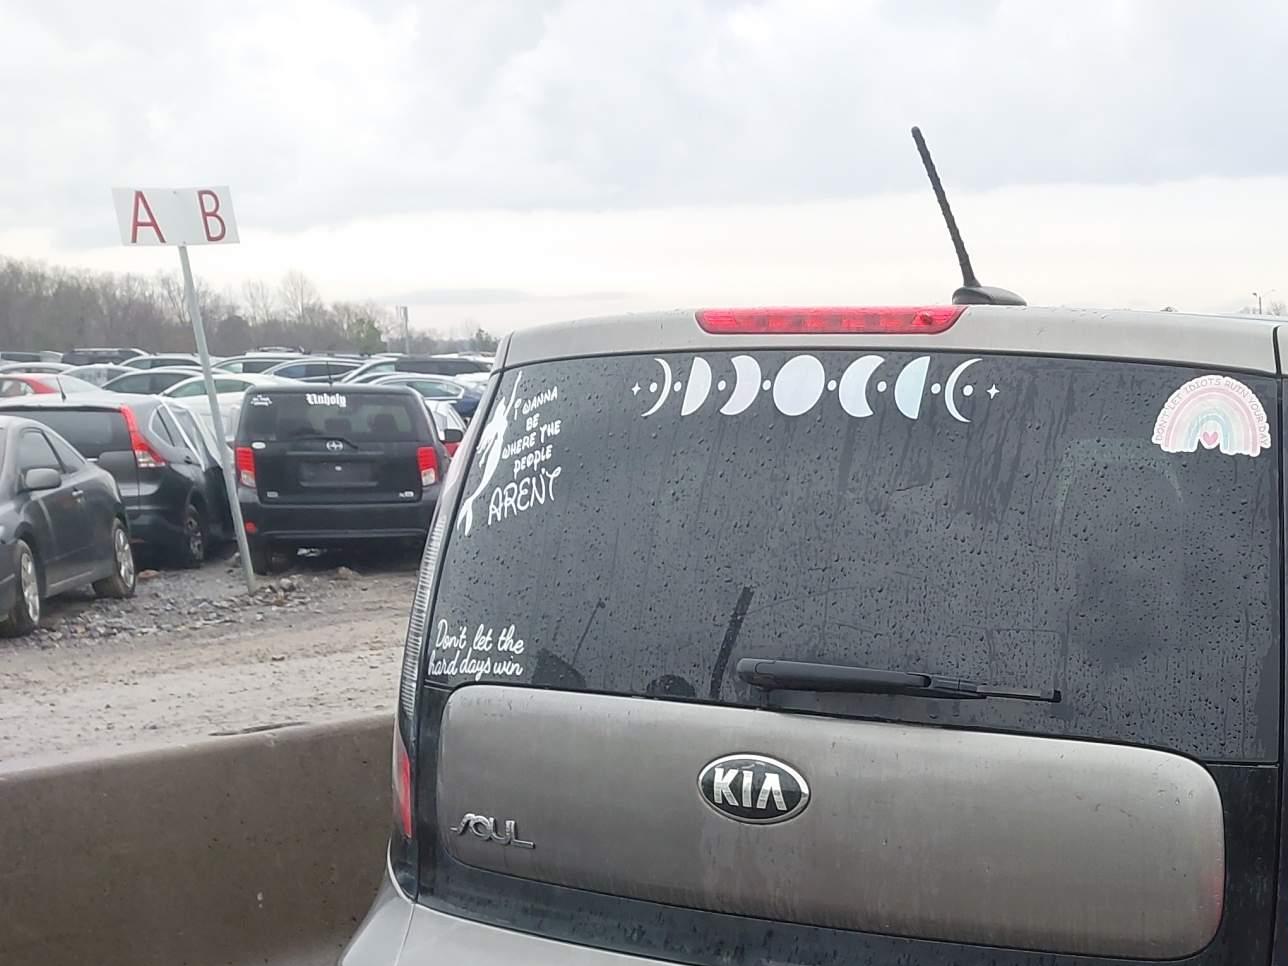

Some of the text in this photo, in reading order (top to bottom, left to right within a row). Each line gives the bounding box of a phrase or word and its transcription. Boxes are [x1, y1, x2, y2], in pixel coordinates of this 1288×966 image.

[131, 189, 227, 244] A B
[305, 392, 347, 408] Unholy
[522, 385, 558, 415] WANNA
[1167, 392, 1184, 411] LET
[1184, 377, 1221, 394] IDIOTS
[1224, 380, 1250, 399] RUIN
[1248, 394, 1264, 423] YOUR
[1258, 424, 1269, 446] DAY
[502, 419, 562, 460] WHERE THE
[526, 413, 540, 432] BE
[435, 618, 525, 654] Don't let the
[428, 647, 524, 682] hard days win
[713, 766, 788, 812] KIA
